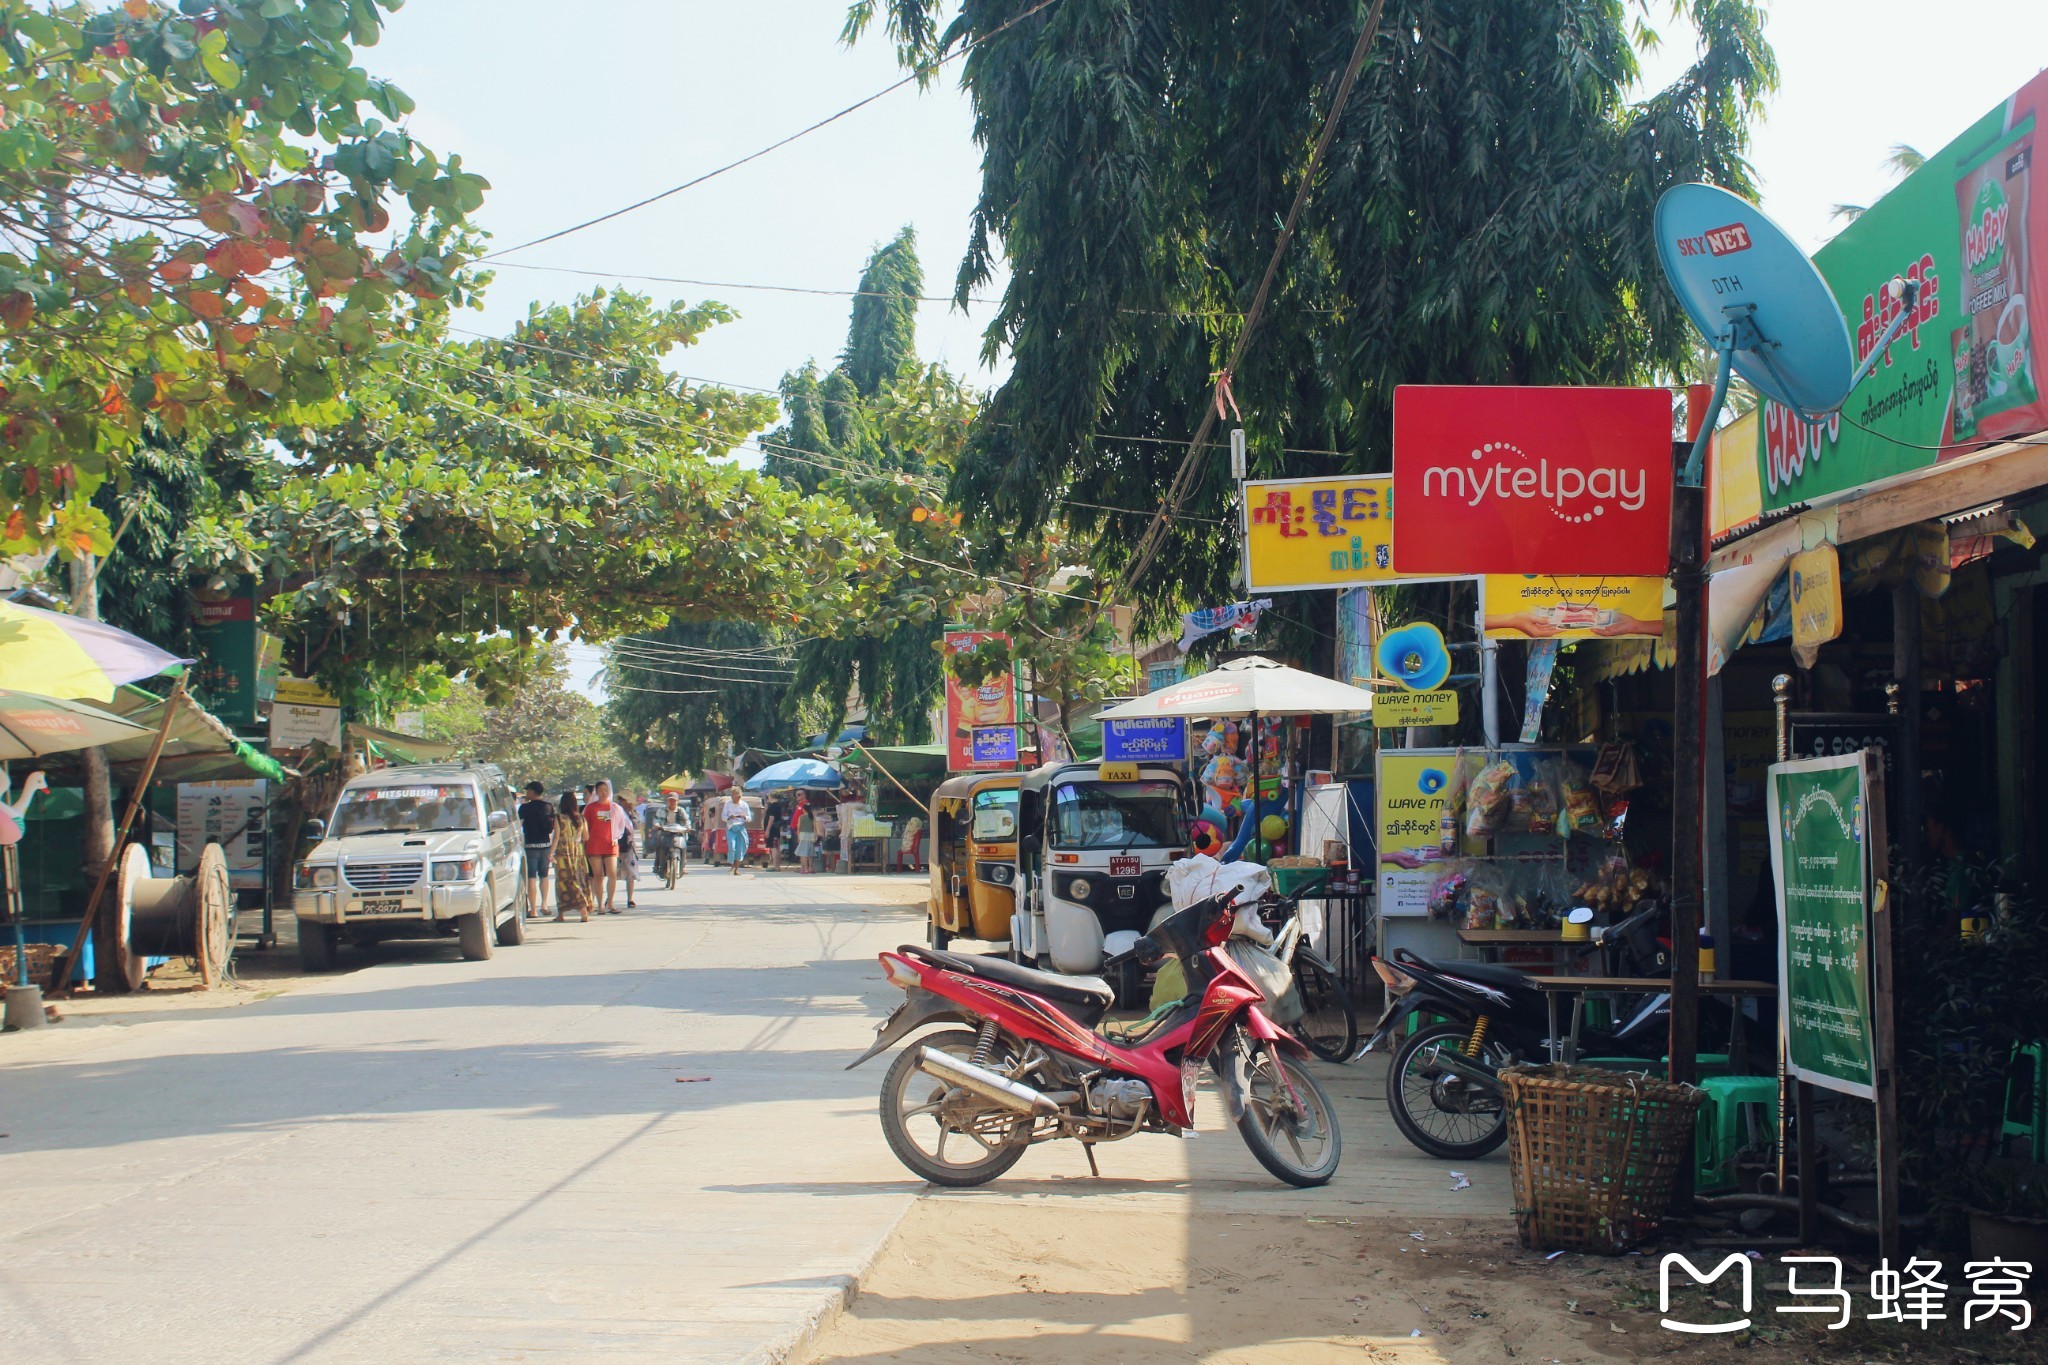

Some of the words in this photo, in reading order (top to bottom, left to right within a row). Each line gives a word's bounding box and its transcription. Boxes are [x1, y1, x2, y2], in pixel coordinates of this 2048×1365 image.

[1965, 207, 2009, 271] HAPPY
[1712, 275, 1744, 295] DTH
[1993, 281, 2008, 304] MIX
[1423, 458, 1647, 512] mytelpay
[1107, 772, 1132, 780] TAXI
[376, 788, 438, 799] MITSUBISHI
[1115, 866, 1136, 875] 1296
